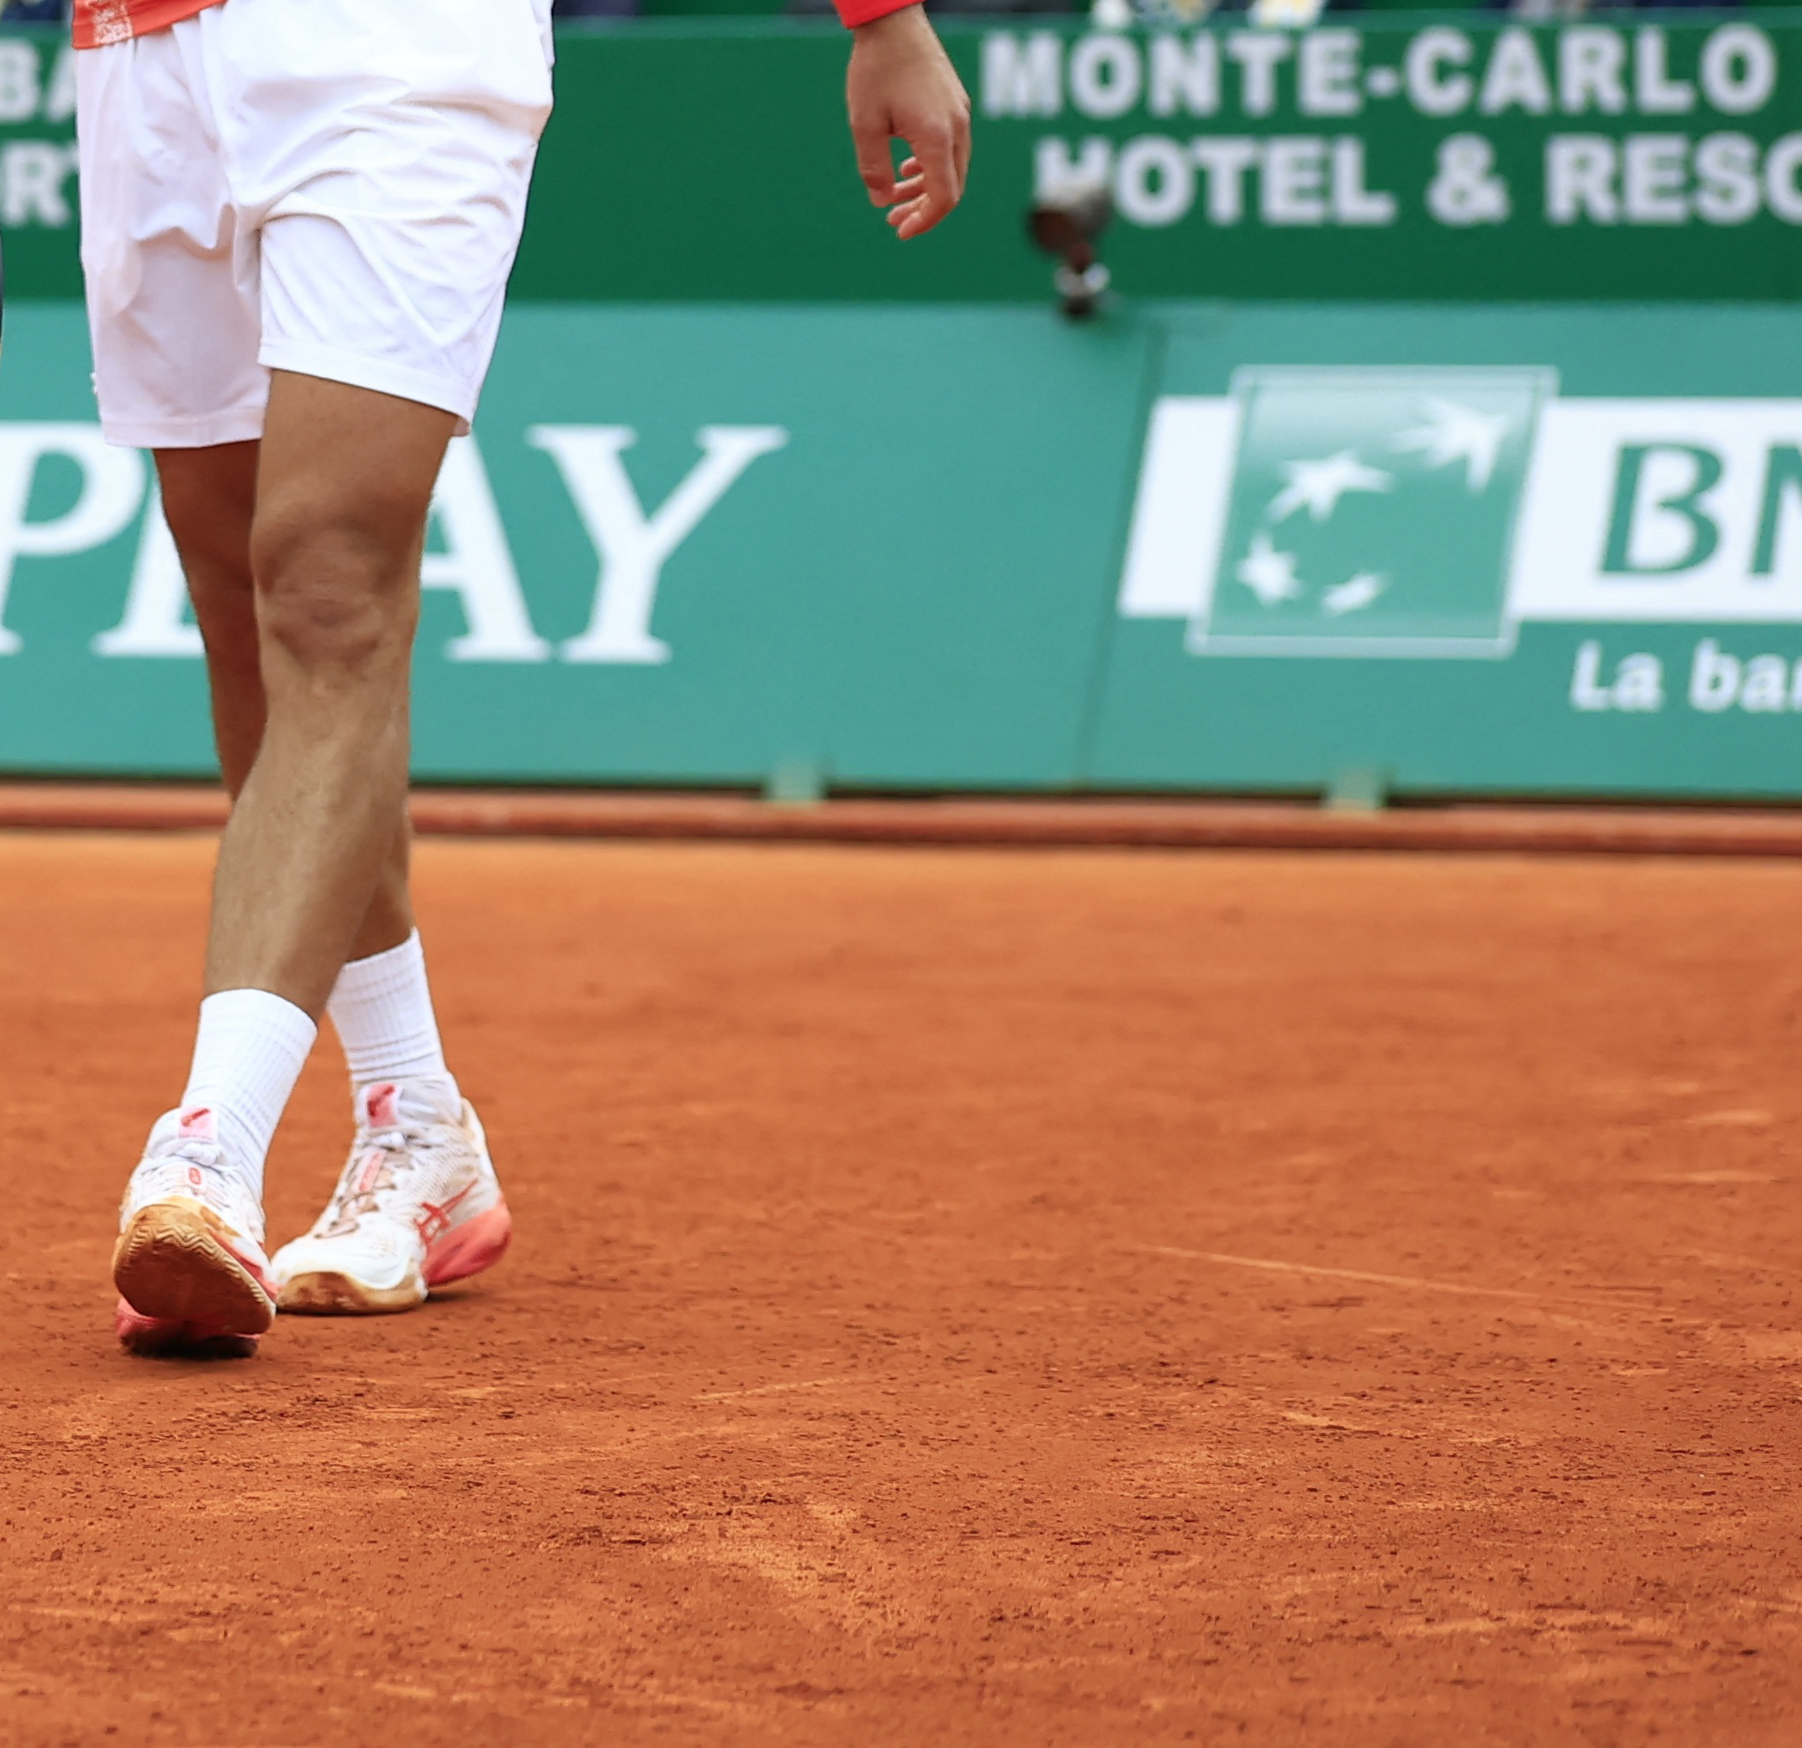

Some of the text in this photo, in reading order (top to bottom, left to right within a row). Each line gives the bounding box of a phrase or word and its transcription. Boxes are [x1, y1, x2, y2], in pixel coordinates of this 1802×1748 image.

[980, 22, 1778, 118] MONTE-CARLO
[1425, 132, 1510, 226] &
[1570, 636, 1664, 713] La
